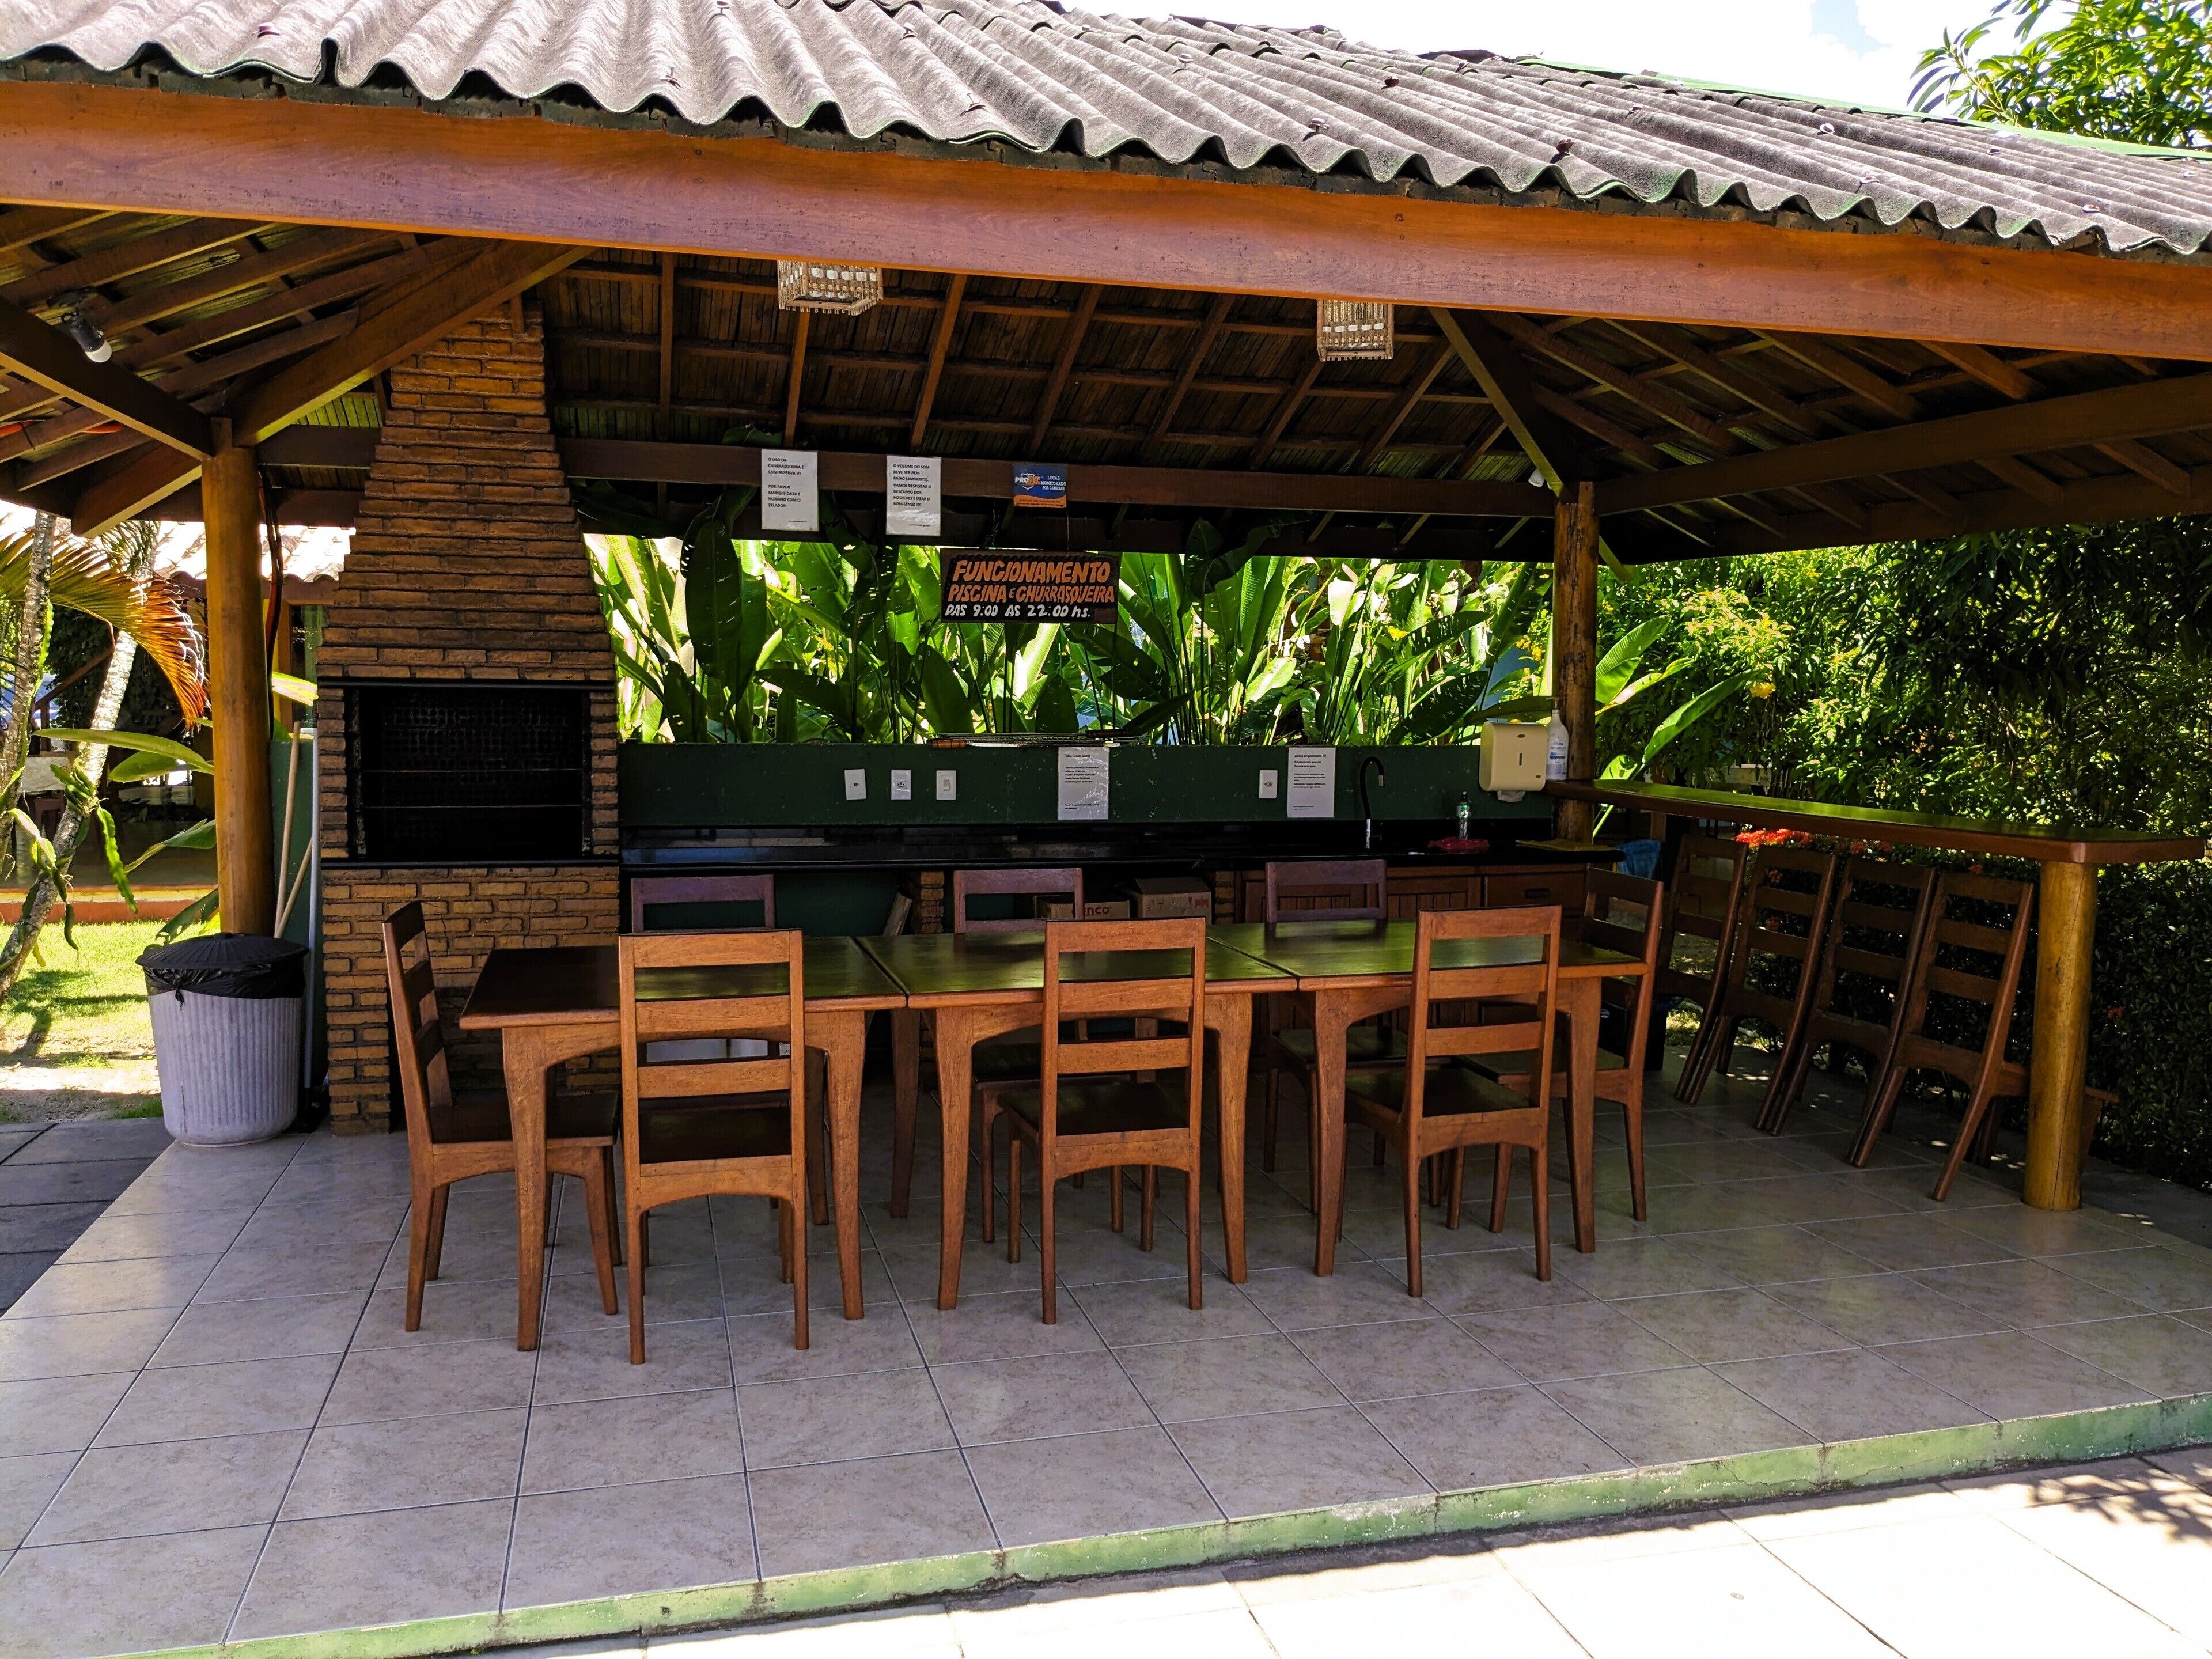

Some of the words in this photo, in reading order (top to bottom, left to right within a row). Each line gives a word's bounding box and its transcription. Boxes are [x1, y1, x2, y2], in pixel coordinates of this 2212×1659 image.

[952, 560, 1111, 584] FUNCIONAMENTO
[948, 584, 1007, 603] PISCINA
[1008, 588, 1016, 599] E
[1016, 585, 1115, 605] CHURRASQUEIRA
[945, 604, 967, 616] DAS
[973, 604, 998, 616] 9:00
[1004, 604, 1021, 617] AS
[1027, 604, 1069, 617] 22:00
[1071, 605, 1090, 618] hs.
